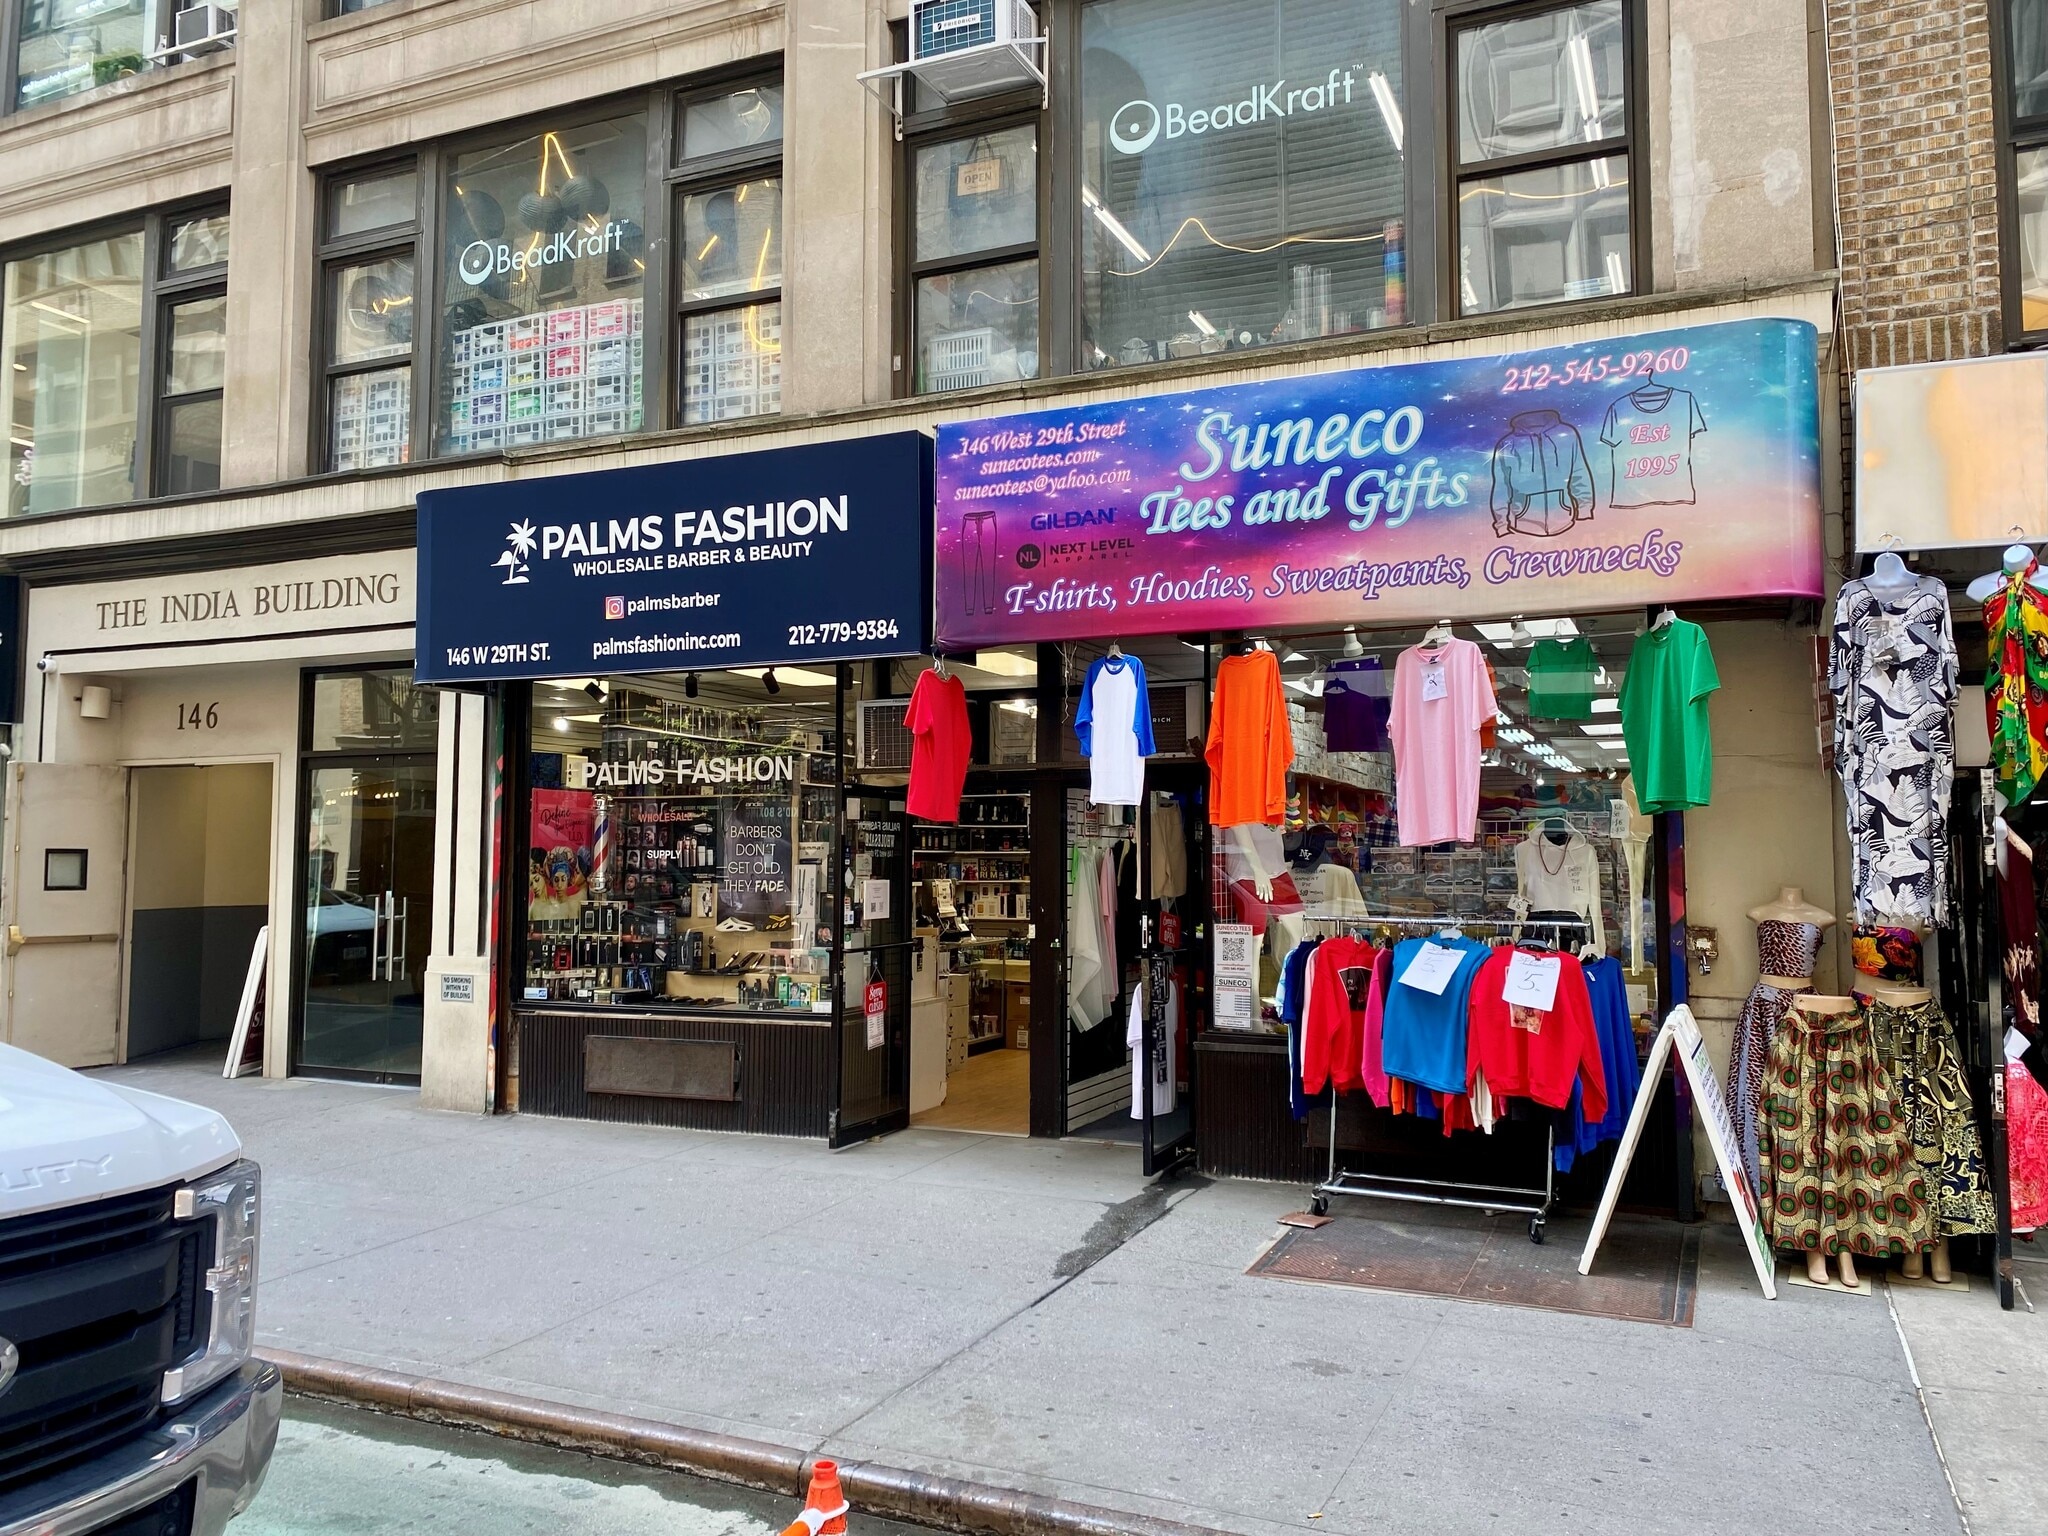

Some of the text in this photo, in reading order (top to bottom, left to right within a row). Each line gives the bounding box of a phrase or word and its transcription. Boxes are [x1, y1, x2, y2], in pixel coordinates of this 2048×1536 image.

[944, 16, 976, 27] FRIEDRICH
[1167, 68, 1355, 140] BeadKraft
[964, 172, 992, 184] OPEN
[496, 221, 622, 274] BeadKraft
[1501, 346, 1689, 393] 212-545-9260
[960, 420, 1127, 457] 146 West 29th Street
[1180, 405, 1424, 481] Suneco
[1629, 423, 1671, 446] Est
[980, 450, 1096, 475] sunecotees.com
[1624, 454, 1679, 479] 1995
[954, 468, 1131, 500] sunecotees@yahoo.com
[1139, 456, 1469, 535] Tees and Gifts
[542, 494, 849, 560] PALMS FASHION
[1030, 509, 1115, 531] GILDAN
[573, 540, 813, 577] WHOLESALE BARBER & BEAUTY
[1020, 549, 1038, 563] NL
[1050, 538, 1135, 555] NEXT LEVEL
[1053, 551, 1132, 564] APPAREL
[1006, 529, 1684, 616] T-shirts, Hoodies, Sweatpants, Crewnecks
[97, 573, 401, 630] THE INDIA BUILDING
[627, 591, 721, 614] palmsbarber
[788, 618, 899, 647] 212-779-9384
[446, 643, 551, 666] 146 W 29TH ST.
[593, 631, 741, 660] palmsfashioninc.com
[176, 702, 220, 730] 146
[581, 755, 793, 787] PALMS FASHION
[638, 812, 693, 823] WHOLESALE
[730, 825, 782, 839] BARBERS
[647, 850, 682, 860] SUPPLY
[736, 843, 776, 856] DON'T
[728, 861, 784, 875] GET OLD.
[724, 879, 787, 893] THEY FADE.
[1218, 979, 1248, 987] SUNECO
[0, 1154, 114, 1193] UTY
